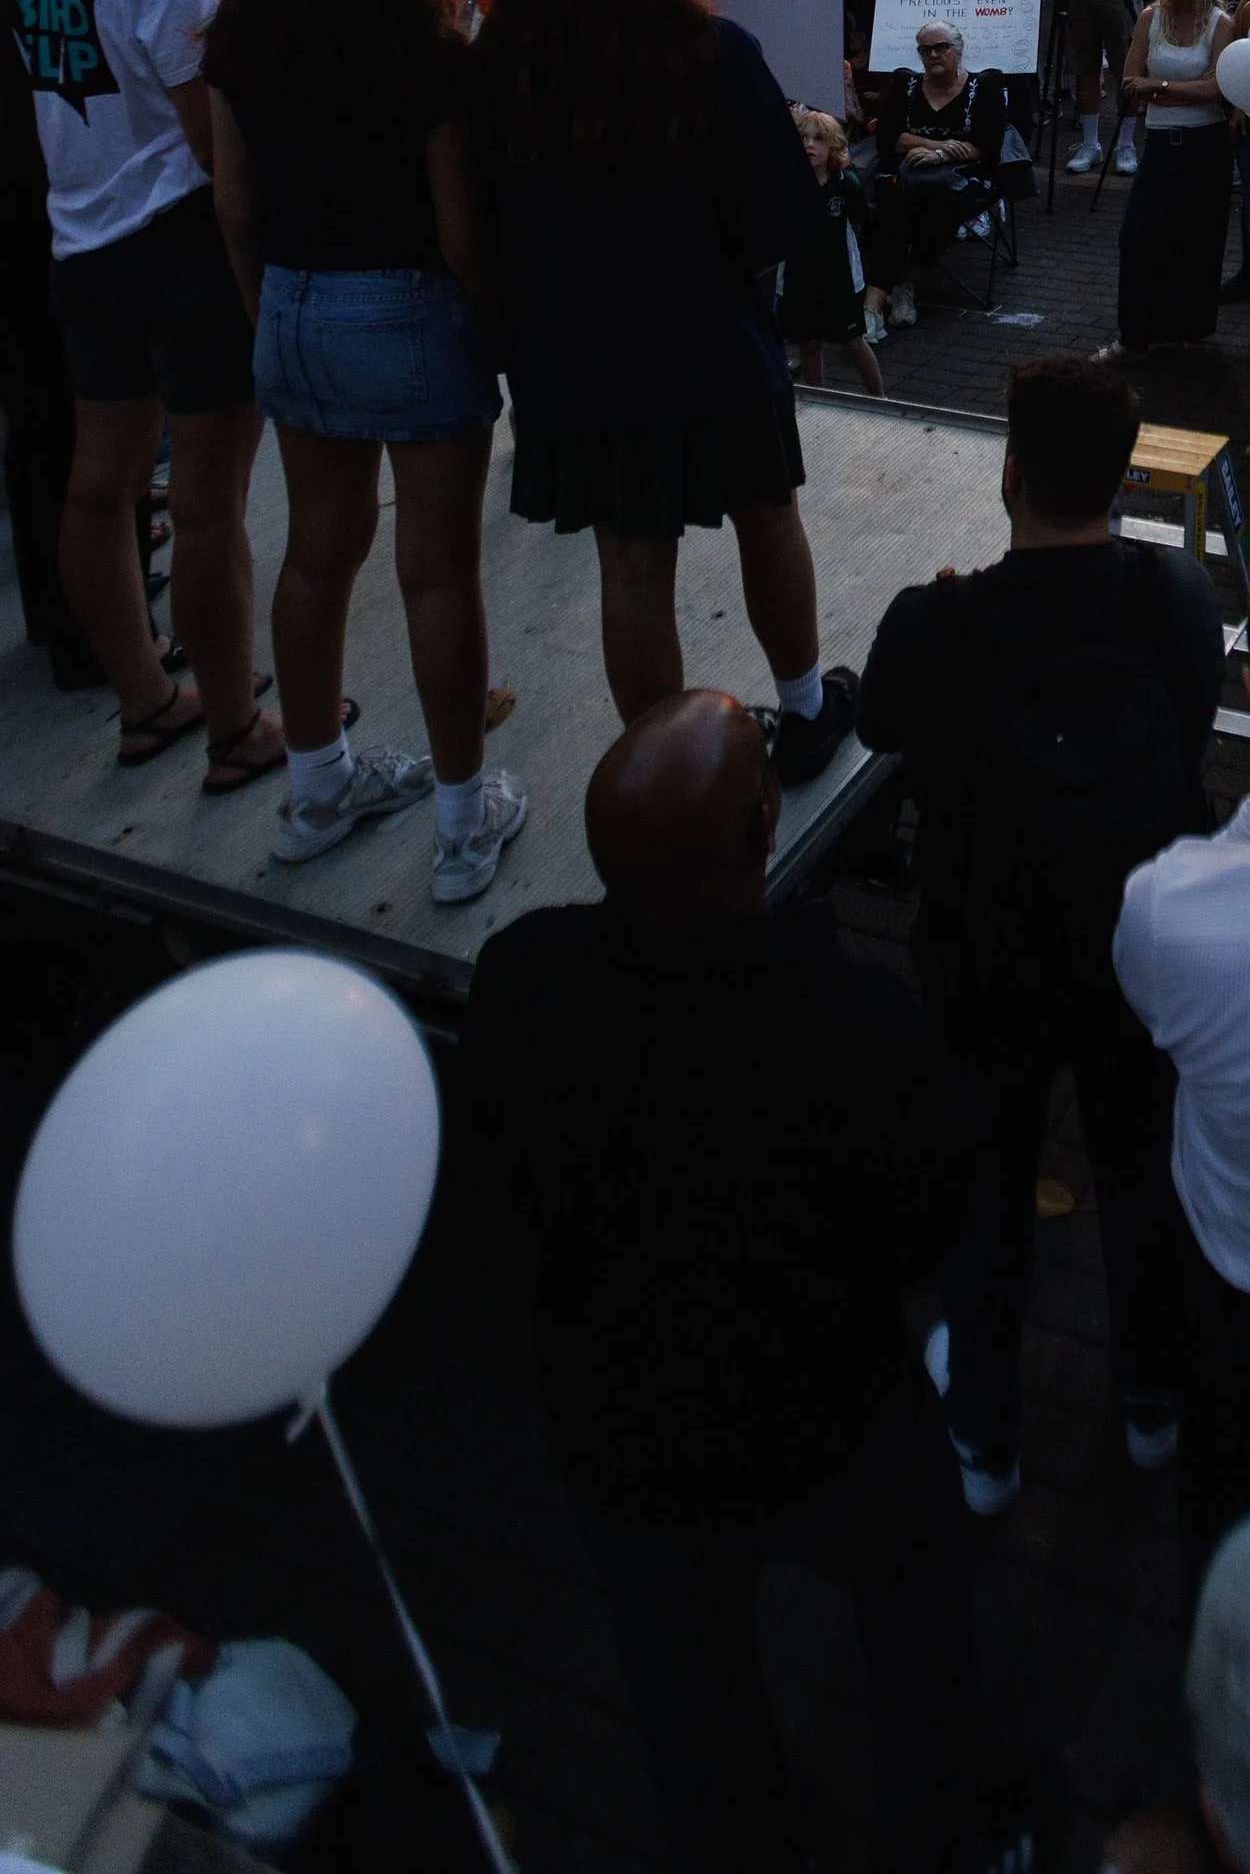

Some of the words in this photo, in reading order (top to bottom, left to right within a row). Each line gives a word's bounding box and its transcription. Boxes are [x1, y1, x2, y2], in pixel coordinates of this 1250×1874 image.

[923, 9, 937, 18] IN
[945, 8, 968, 18] THE
[1126, 468, 1149, 482] LEY
